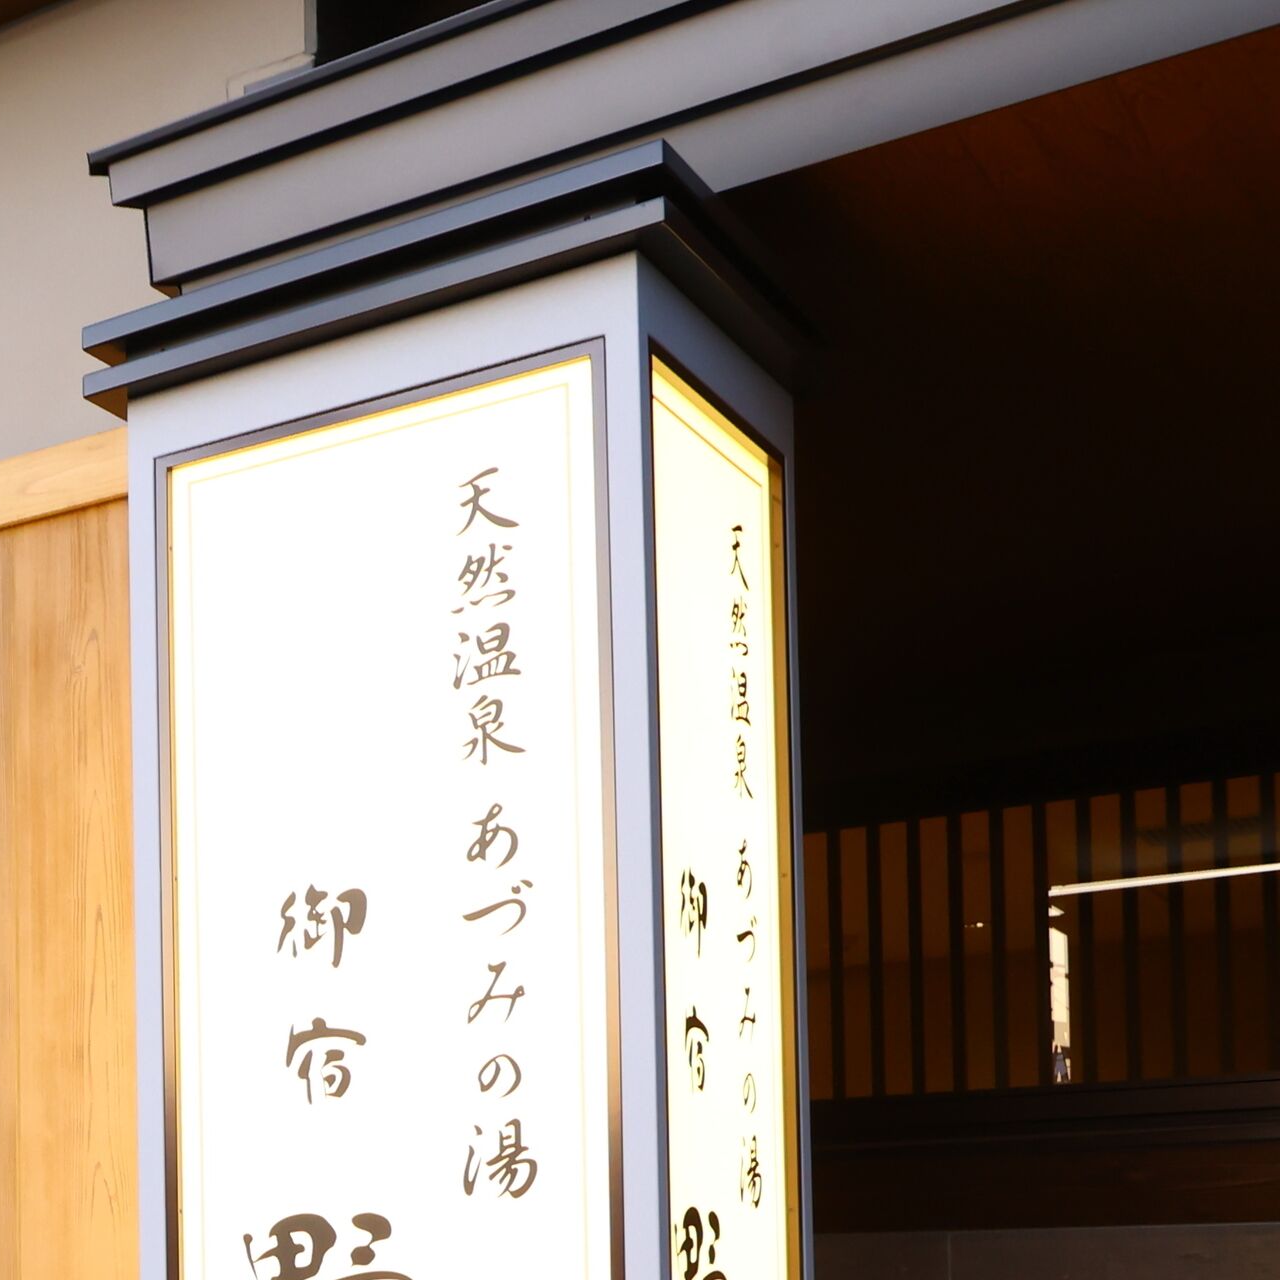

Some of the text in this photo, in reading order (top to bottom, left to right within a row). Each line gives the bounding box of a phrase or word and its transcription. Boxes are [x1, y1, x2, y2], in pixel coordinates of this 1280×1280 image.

[452, 468, 538, 1199] 天然温泉 あづみの湯
[729, 524, 762, 1209] 天然温泉 あづみの湯
